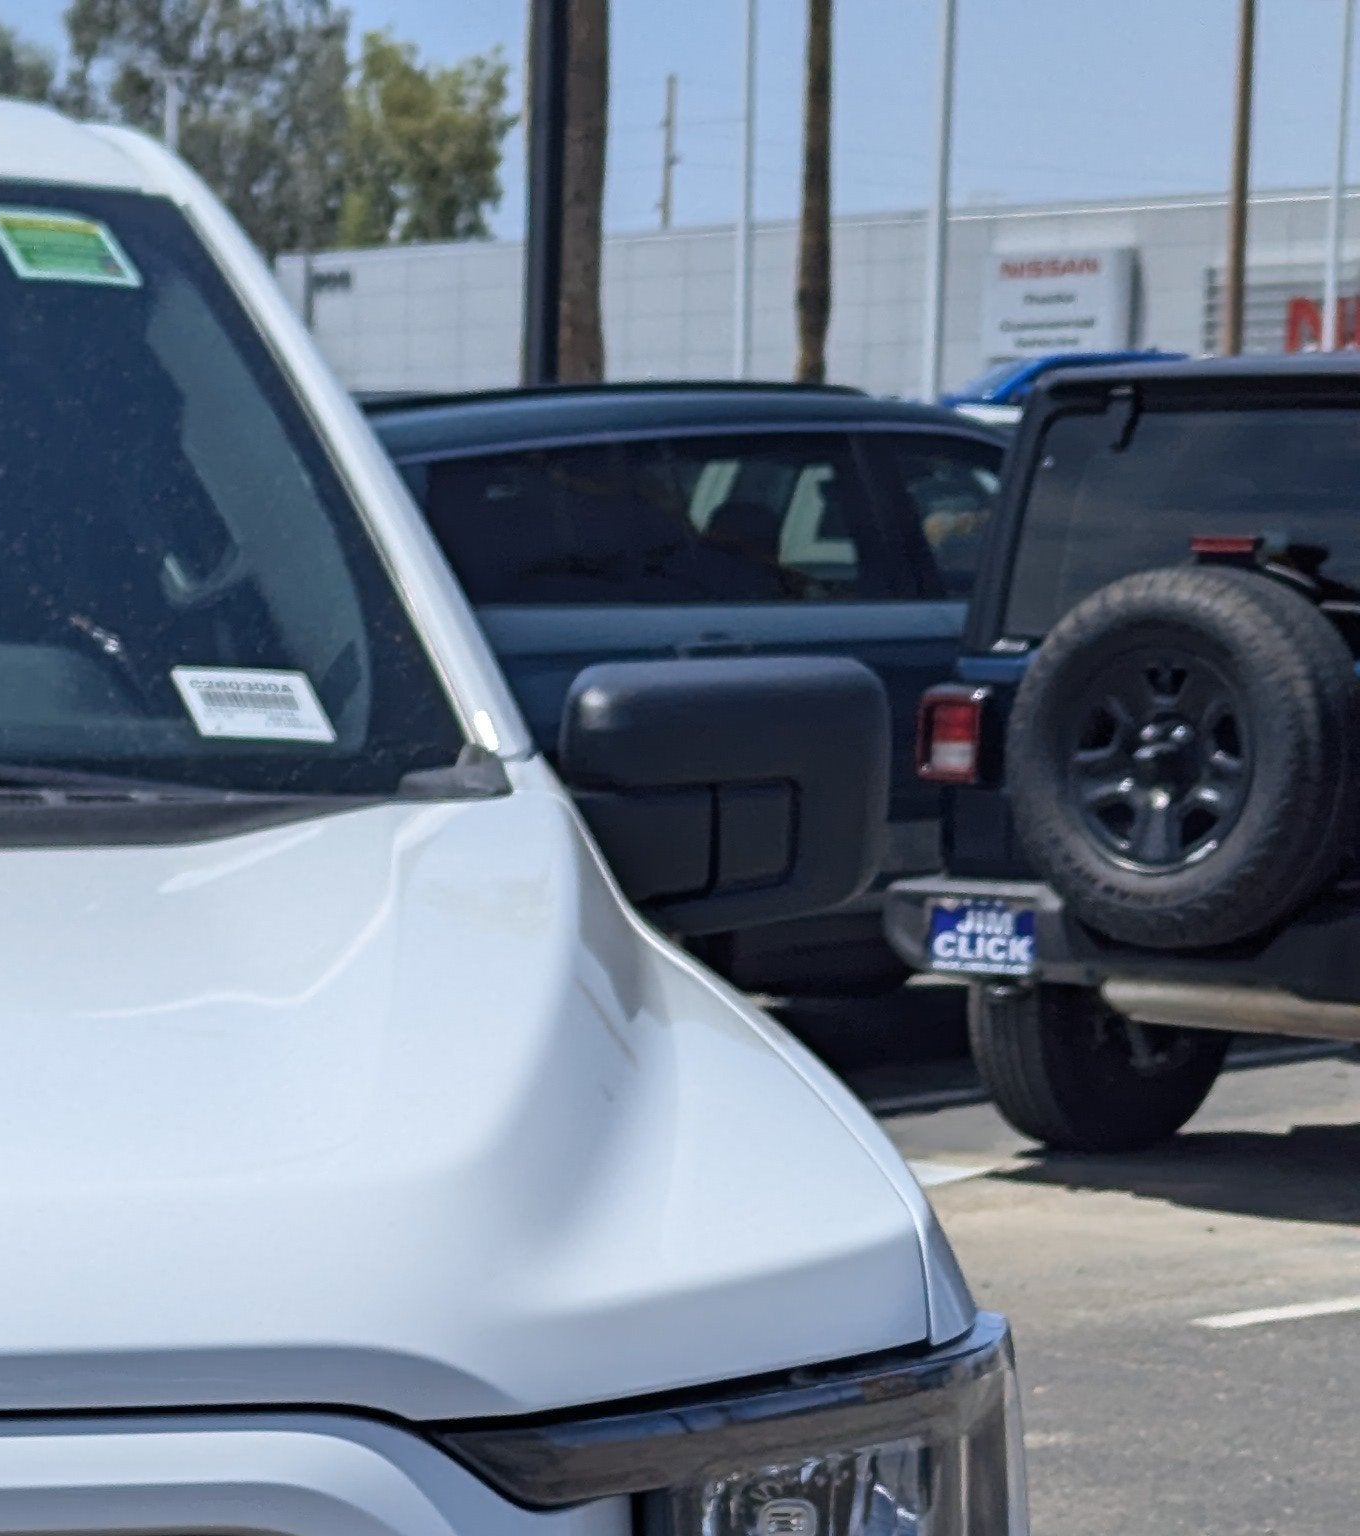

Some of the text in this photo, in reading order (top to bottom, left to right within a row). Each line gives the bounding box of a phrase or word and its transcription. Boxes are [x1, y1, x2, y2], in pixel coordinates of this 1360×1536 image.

[999, 257, 1100, 278] NISSAN
[956, 910, 1014, 936] JIM
[932, 931, 1032, 962] CLICK
